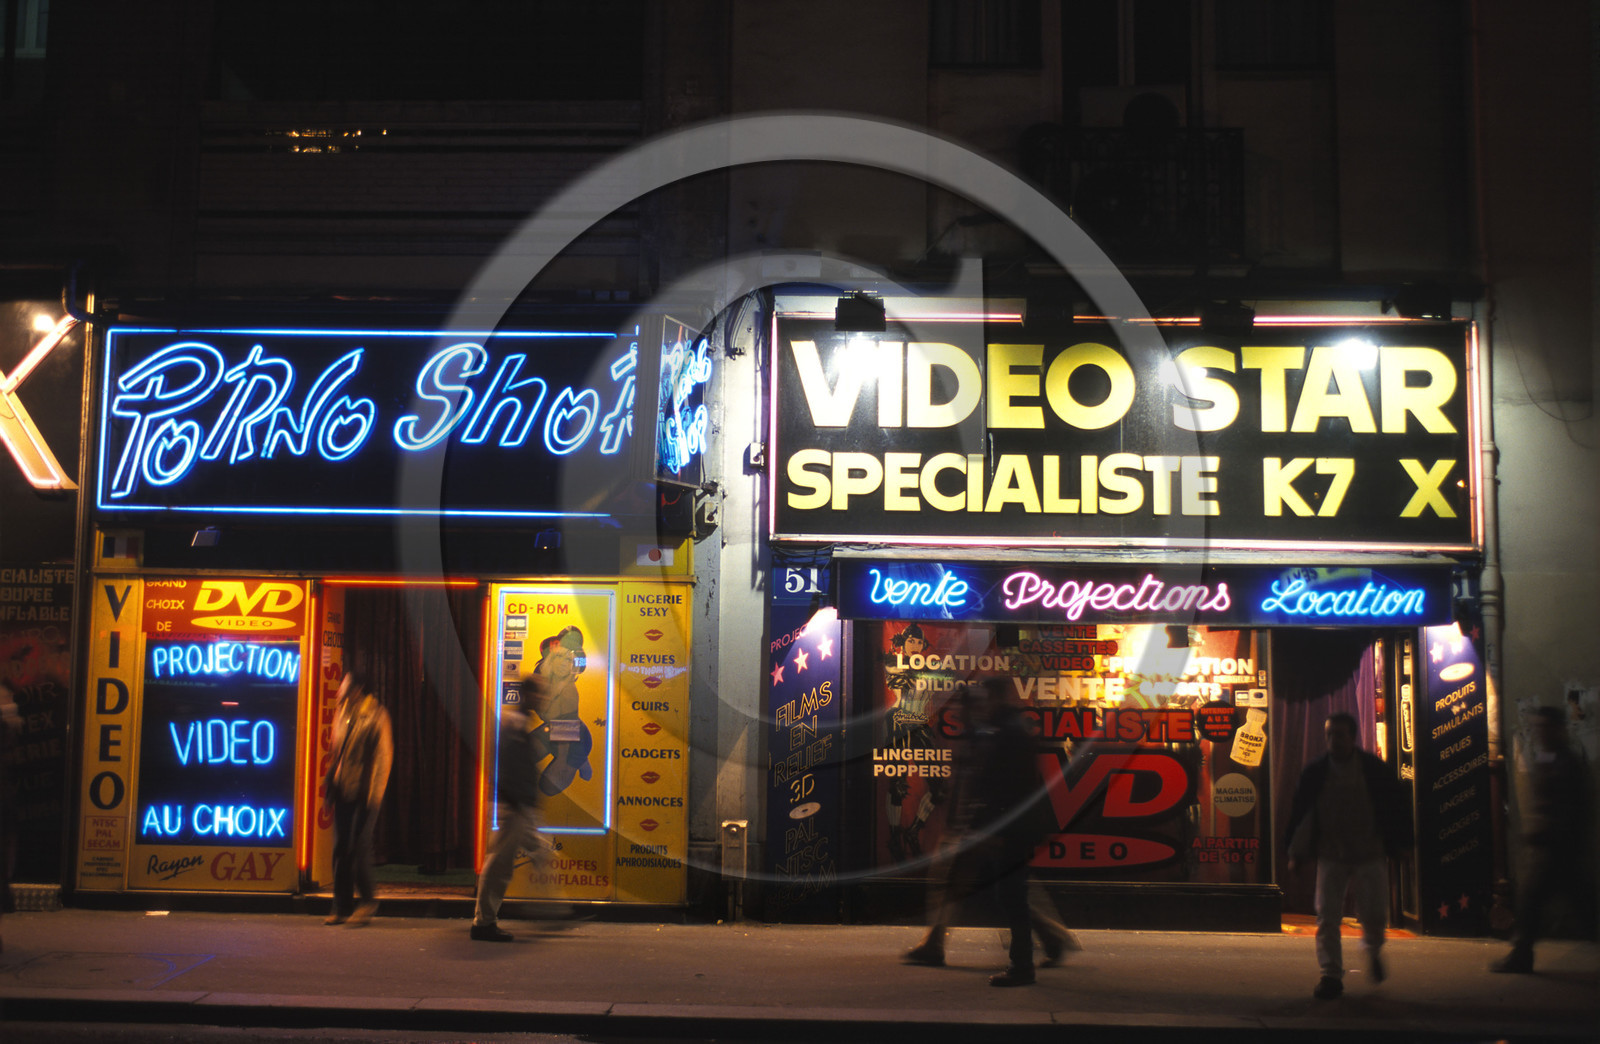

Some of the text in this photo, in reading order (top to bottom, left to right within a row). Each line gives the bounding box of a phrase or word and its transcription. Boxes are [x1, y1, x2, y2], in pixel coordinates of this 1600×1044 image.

[790, 340, 1136, 430] VIDEO
[1172, 345, 1458, 433] STAR
[787, 449, 1457, 518] SPECIALISTE K7 X
[785, 568, 822, 593] 51
[146, 599, 185, 610] CHOIX
[193, 581, 304, 617] DVD
[626, 594, 683, 605] LINGERIE
[1003, 571, 1231, 621] Projections
[1261, 579, 1426, 617] Location
[507, 603, 569, 615] CD-ROM
[639, 607, 669, 617] SEXY
[156, 620, 172, 632] DE
[215, 619, 273, 628] VIDEO
[1041, 625, 1097, 638] VENTE
[1020, 640, 1118, 655] CASSETTES
[152, 641, 301, 683] PROJECTION
[630, 654, 676, 665] REVUES
[897, 653, 1010, 672] LOCATION
[1042, 656, 1095, 670] VIDEO
[89, 584, 132, 810] VIDEO
[1012, 677, 1125, 700] VENTE
[1435, 681, 1476, 712] PRODUITS
[631, 701, 670, 712] CUIRS
[775, 680, 833, 732] FILMS
[1432, 702, 1484, 740] STIMULANTS
[169, 719, 276, 766] VIDEO
[790, 714, 818, 751] EN
[1240, 731, 1264, 743] BRONX
[621, 748, 681, 760] GADGETS
[873, 748, 953, 761] LINGERIE
[1440, 735, 1472, 761] REVUES
[774, 733, 833, 788] RELIEF
[873, 764, 952, 778] POPPERS
[1432, 753, 1488, 792] ACCESSOIRES
[789, 773, 815, 804] 3D
[1215, 787, 1253, 795] MAGASIN
[617, 796, 684, 807] ANNONCES
[142, 804, 287, 837] AU CHOIX
[785, 816, 819, 855] PAL
[1207, 837, 1260, 849] PARTIR
[630, 844, 668, 855] PRODUITS
[1199, 851, 1217, 863] DE
[146, 853, 204, 880] Rayon
[210, 851, 285, 881] GAY
[616, 857, 682, 869] APHRODISIAQUES
[775, 836, 829, 886] NTSC
